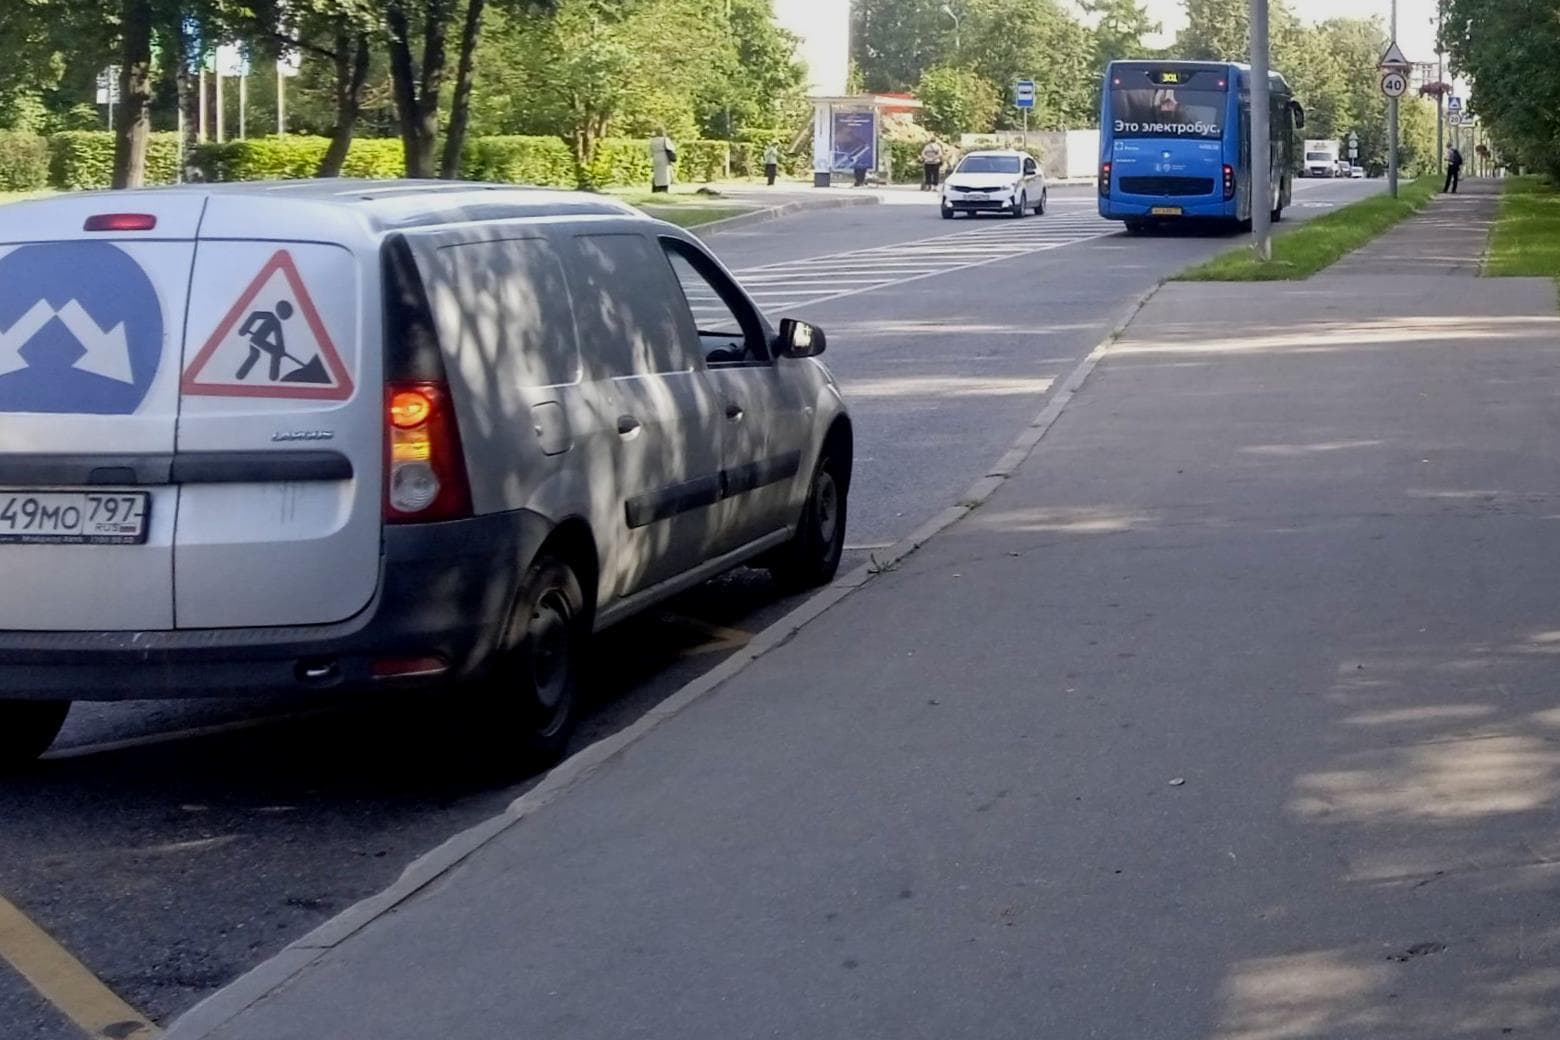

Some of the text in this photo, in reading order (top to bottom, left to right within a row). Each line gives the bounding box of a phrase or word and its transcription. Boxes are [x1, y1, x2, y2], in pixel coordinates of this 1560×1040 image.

[1385, 79, 1402, 90] 40
[1114, 119, 1221, 136] Это электробус.
[88, 497, 136, 522] 797
